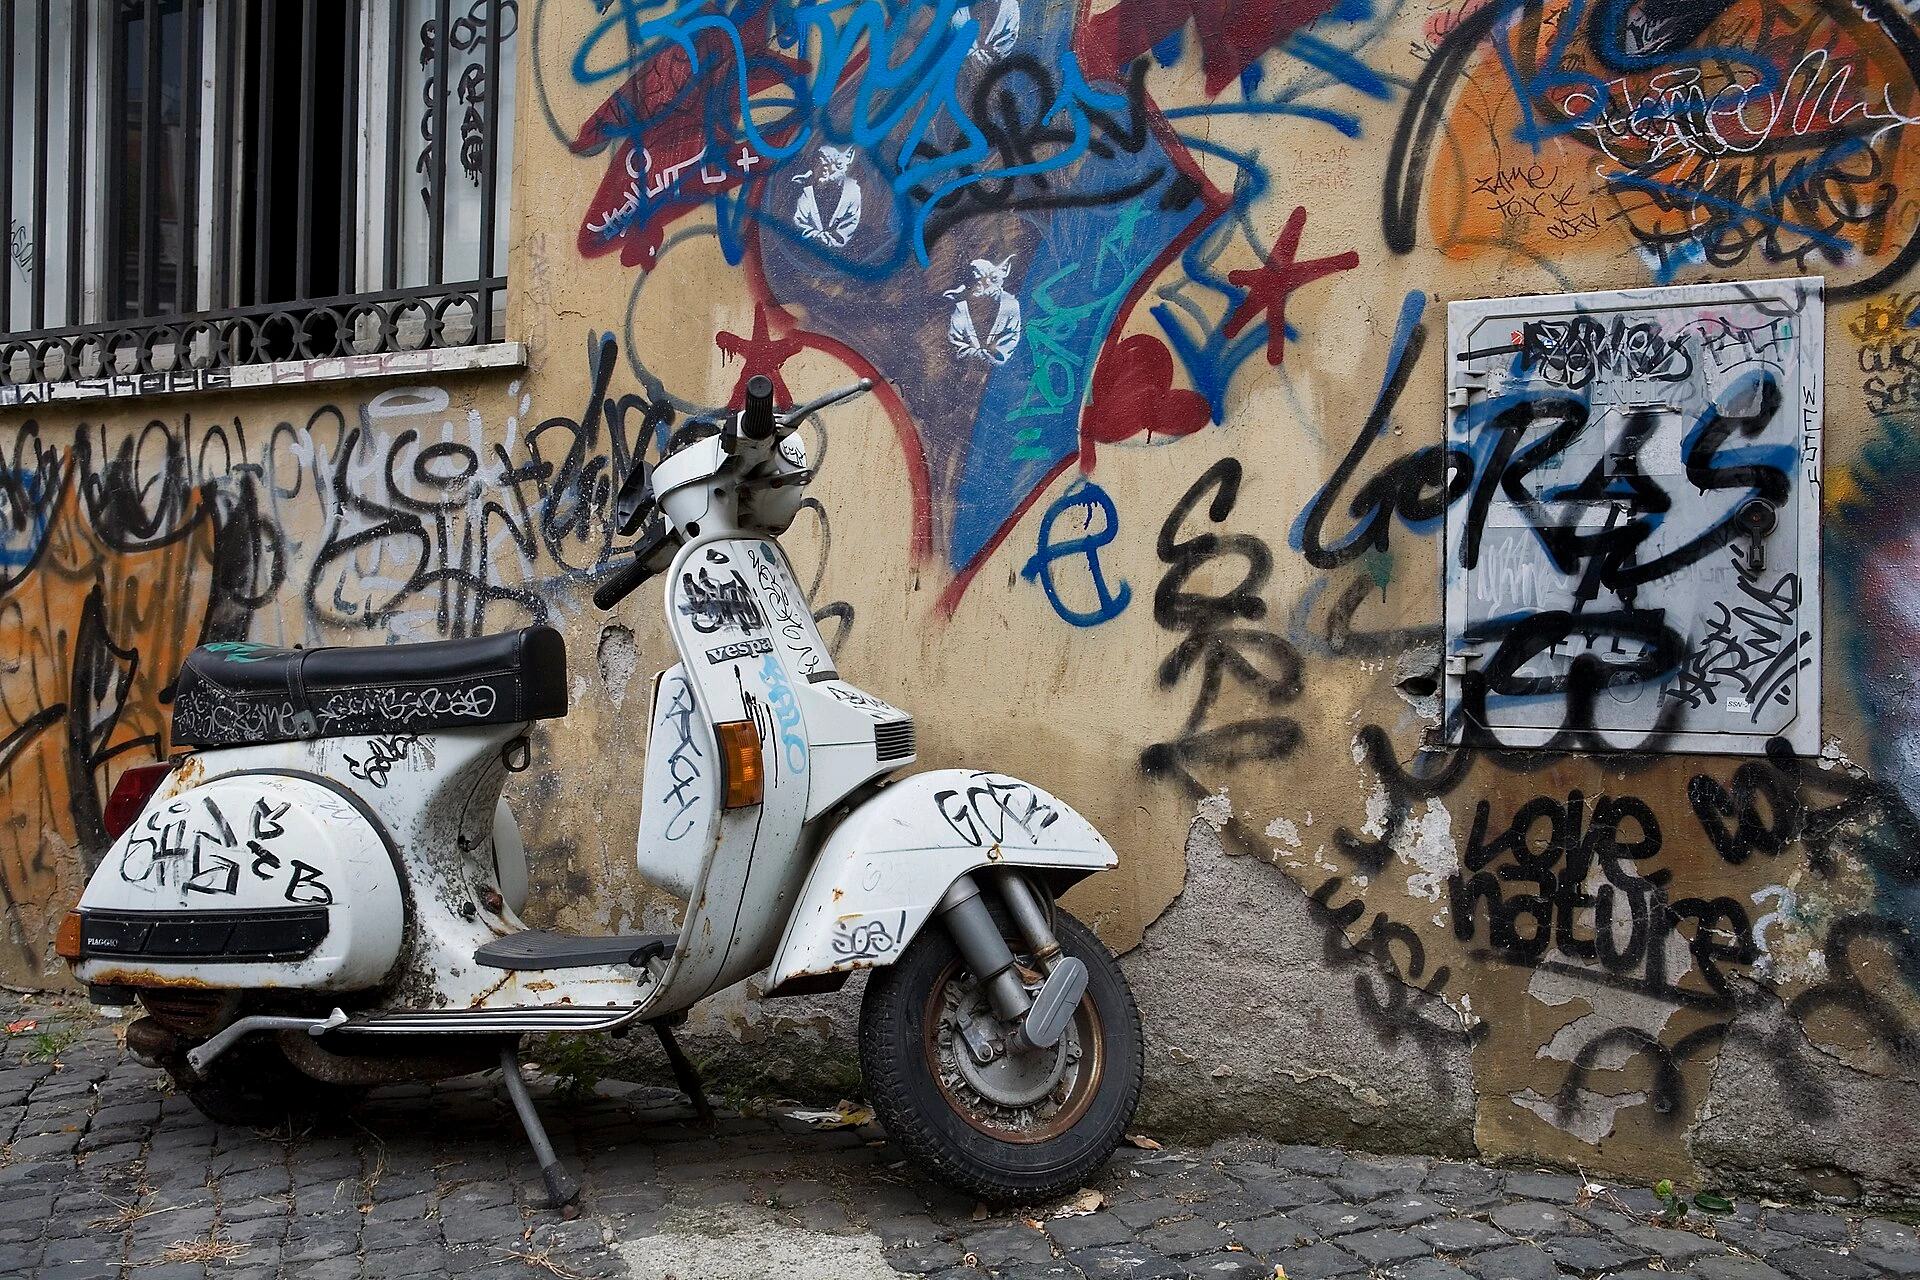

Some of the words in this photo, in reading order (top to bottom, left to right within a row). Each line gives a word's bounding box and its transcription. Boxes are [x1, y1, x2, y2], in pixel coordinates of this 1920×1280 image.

[1590, 380, 1667, 405] ENEL
[707, 638, 773, 662] vespa
[87, 937, 119, 950] PIAGGIO
